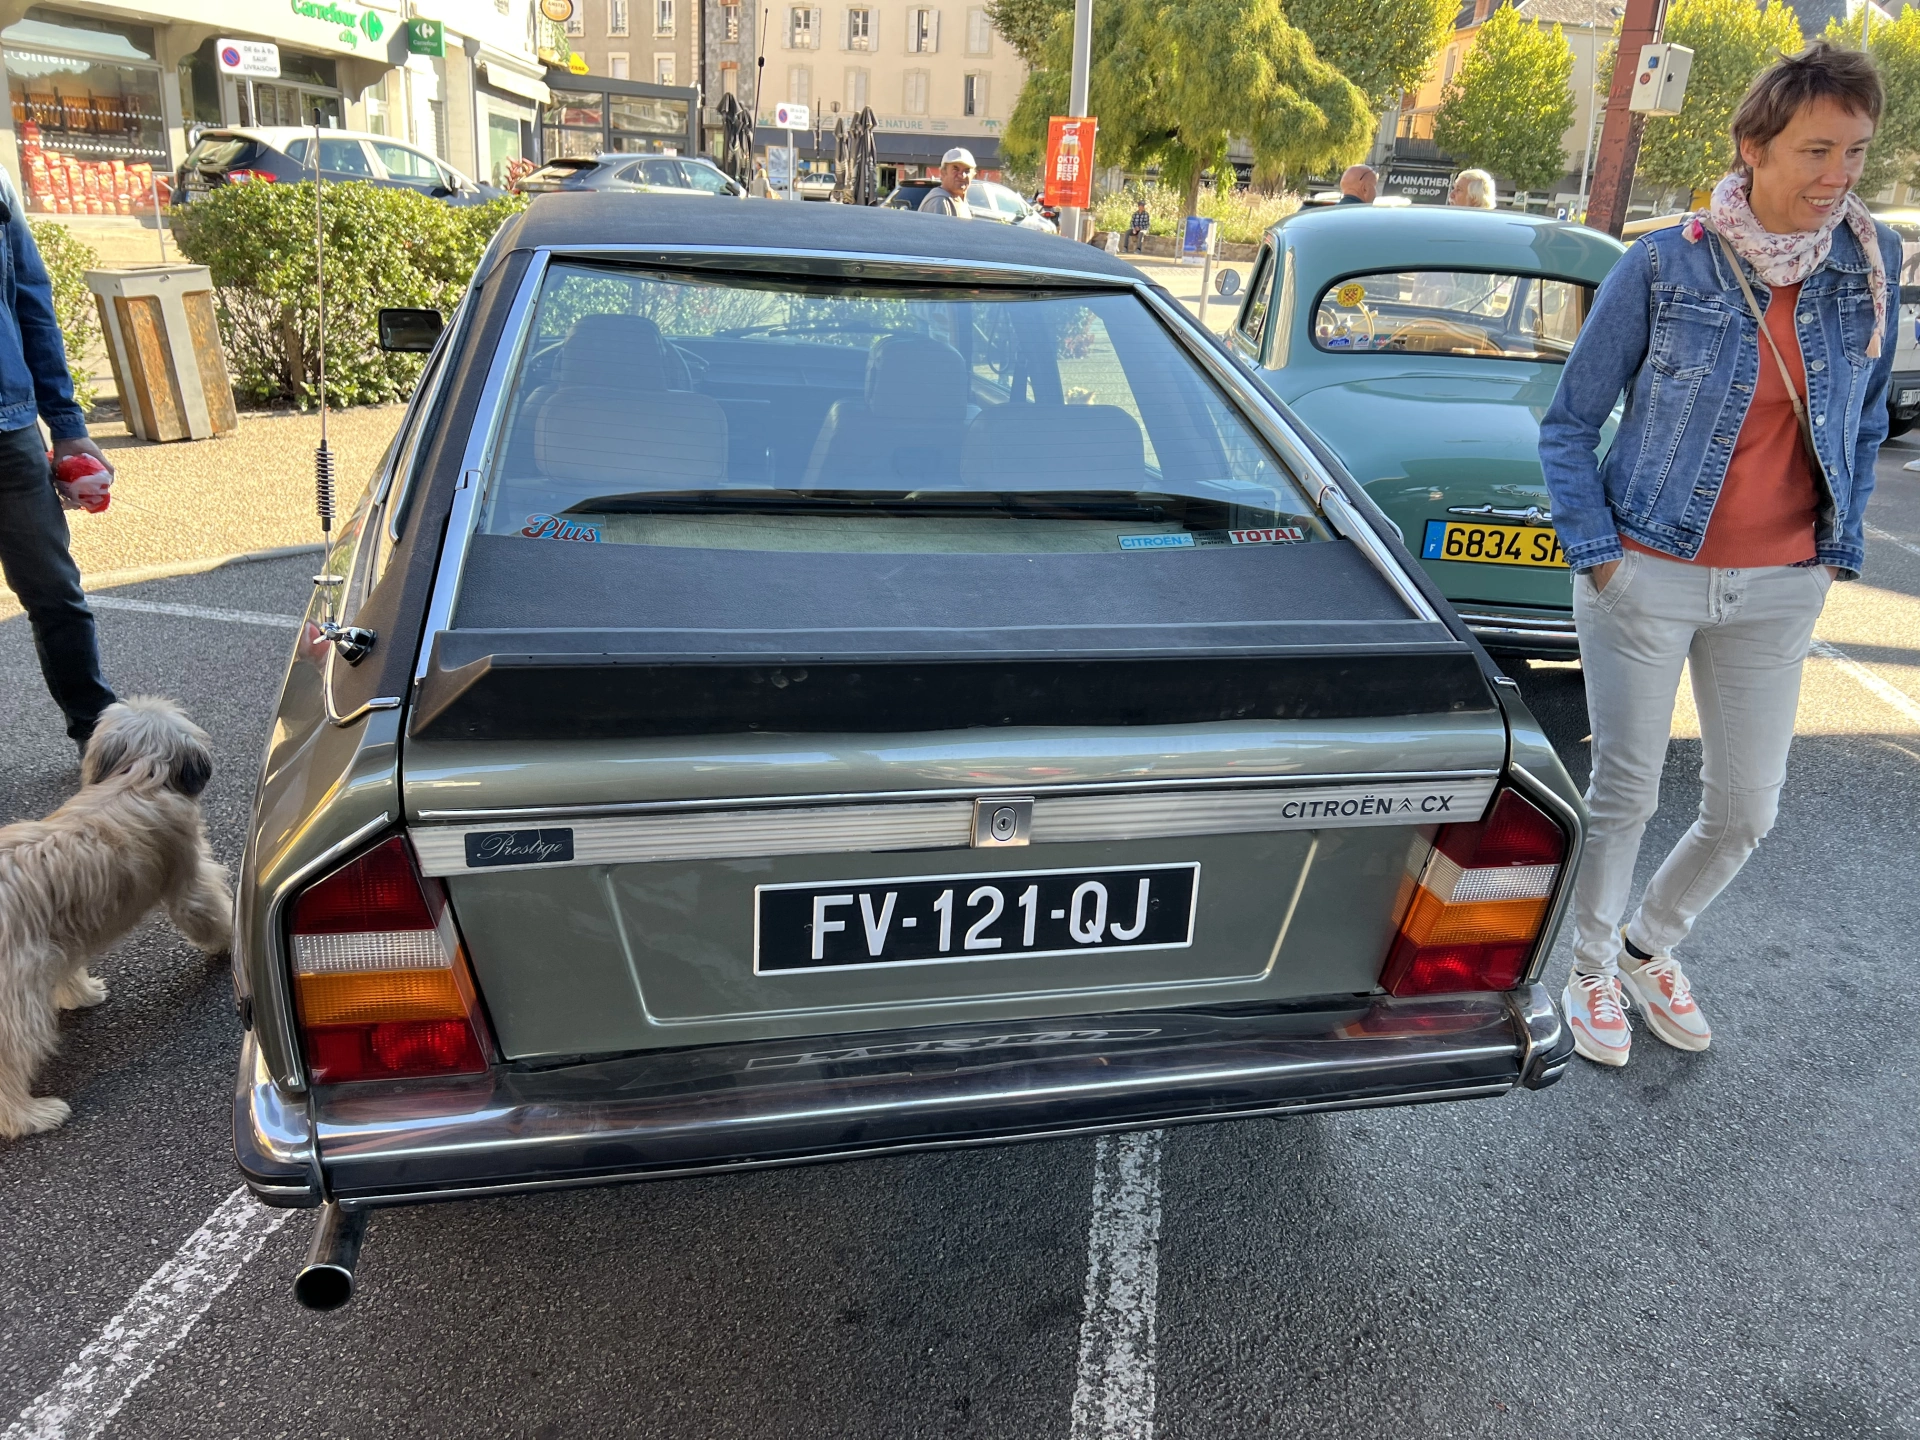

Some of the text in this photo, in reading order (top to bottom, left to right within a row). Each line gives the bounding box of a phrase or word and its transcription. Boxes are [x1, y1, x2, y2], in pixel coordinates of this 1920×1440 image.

[291, 0, 357, 28] Carrefour
[339, 29, 358, 50] city
[412, 39, 438, 47] Carrefour
[243, 63, 278, 73] LIVRAISONS
[885, 119, 924, 129] NATURE
[1057, 155, 1080, 164] OKTO
[1056, 164, 1080, 173] BEER
[1056, 173, 1078, 182] FEST
[1402, 187, 1441, 196] CBD SHOP
[1558, 207, 1566, 219] P
[521, 513, 596, 542] Plus
[1231, 528, 1302, 543] TOTAL
[1120, 536, 1183, 548] CITROËN
[1446, 528, 1522, 560] 6834
[1429, 544, 1436, 553] F
[1282, 795, 1454, 819] CITROËN CX
[476, 831, 564, 861] Prestige
[811, 877, 1151, 960] FV-121-QJ
